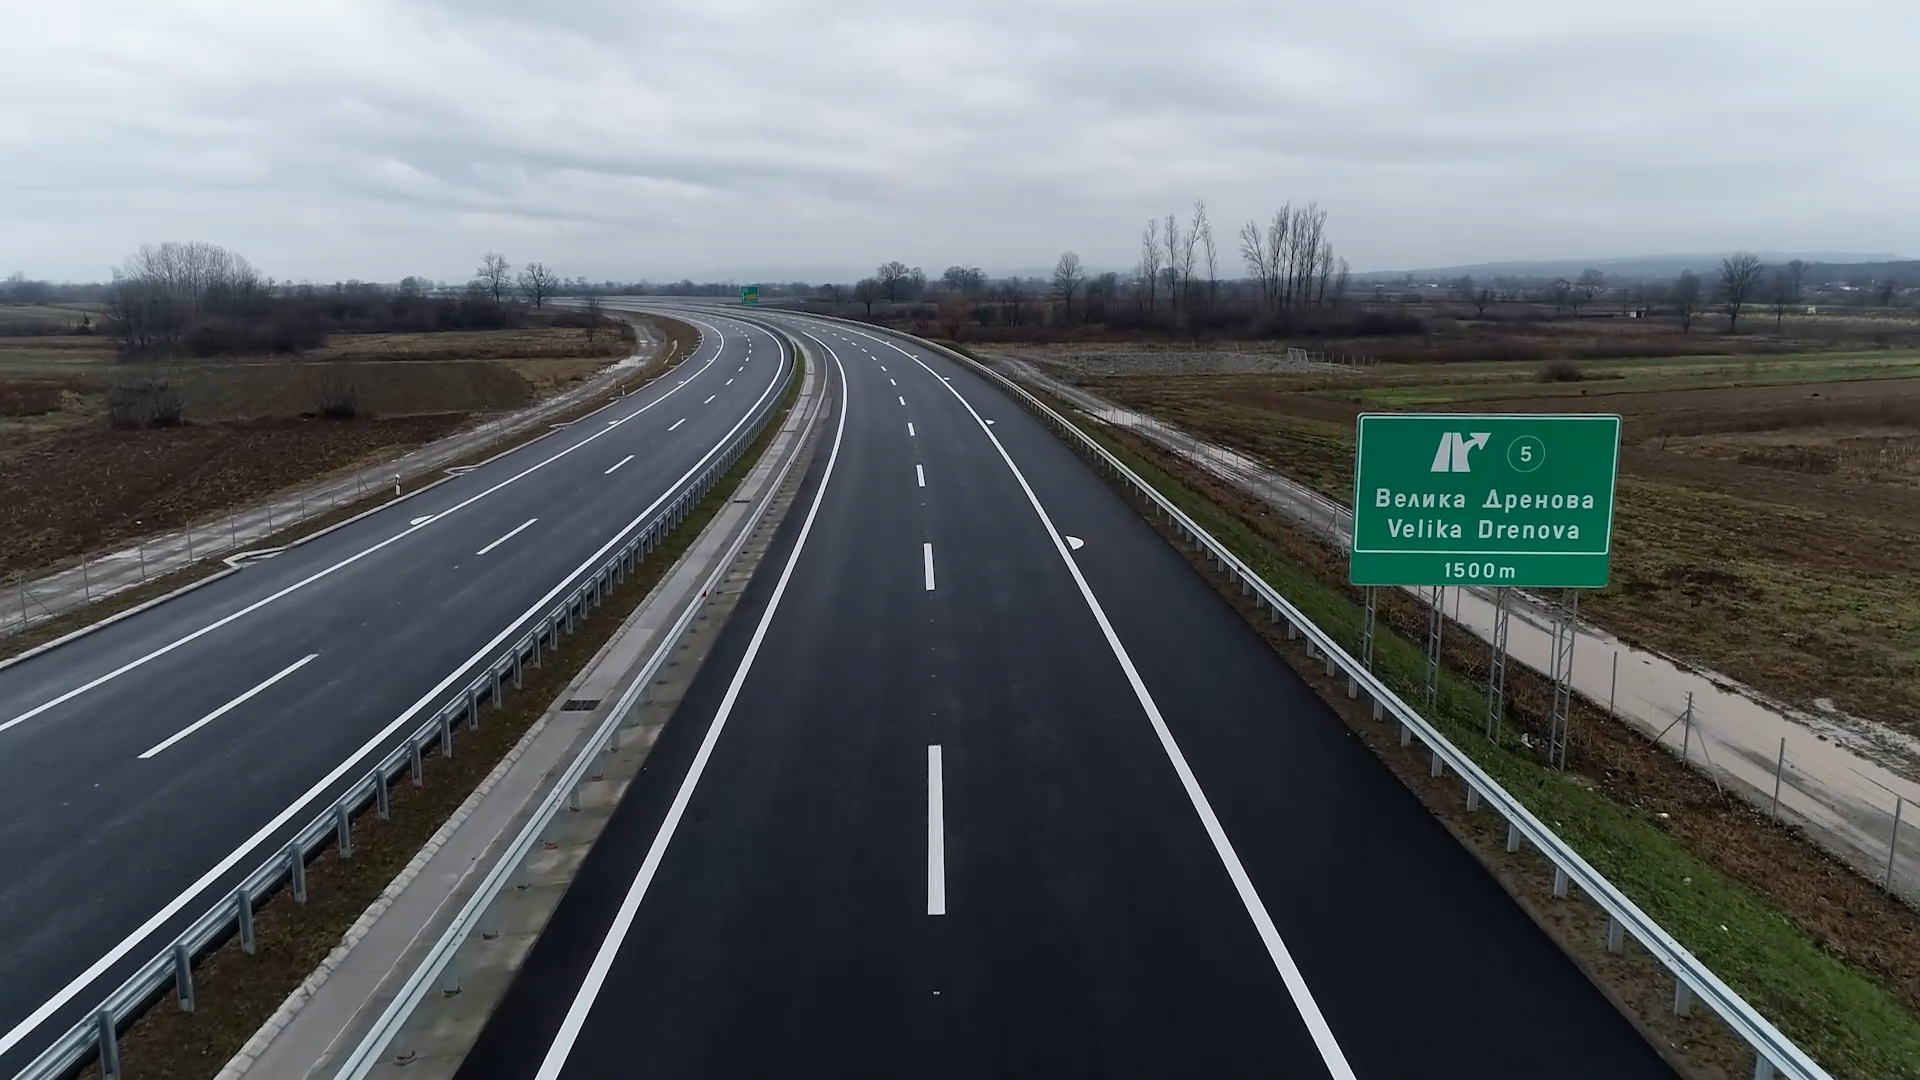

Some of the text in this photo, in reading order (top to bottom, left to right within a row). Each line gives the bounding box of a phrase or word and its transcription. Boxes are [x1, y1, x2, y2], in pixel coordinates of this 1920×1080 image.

[1520, 446, 1532, 462] 5
[1376, 488, 1594, 513] Велика Дренова
[1387, 519, 1580, 540] Velika Drenova
